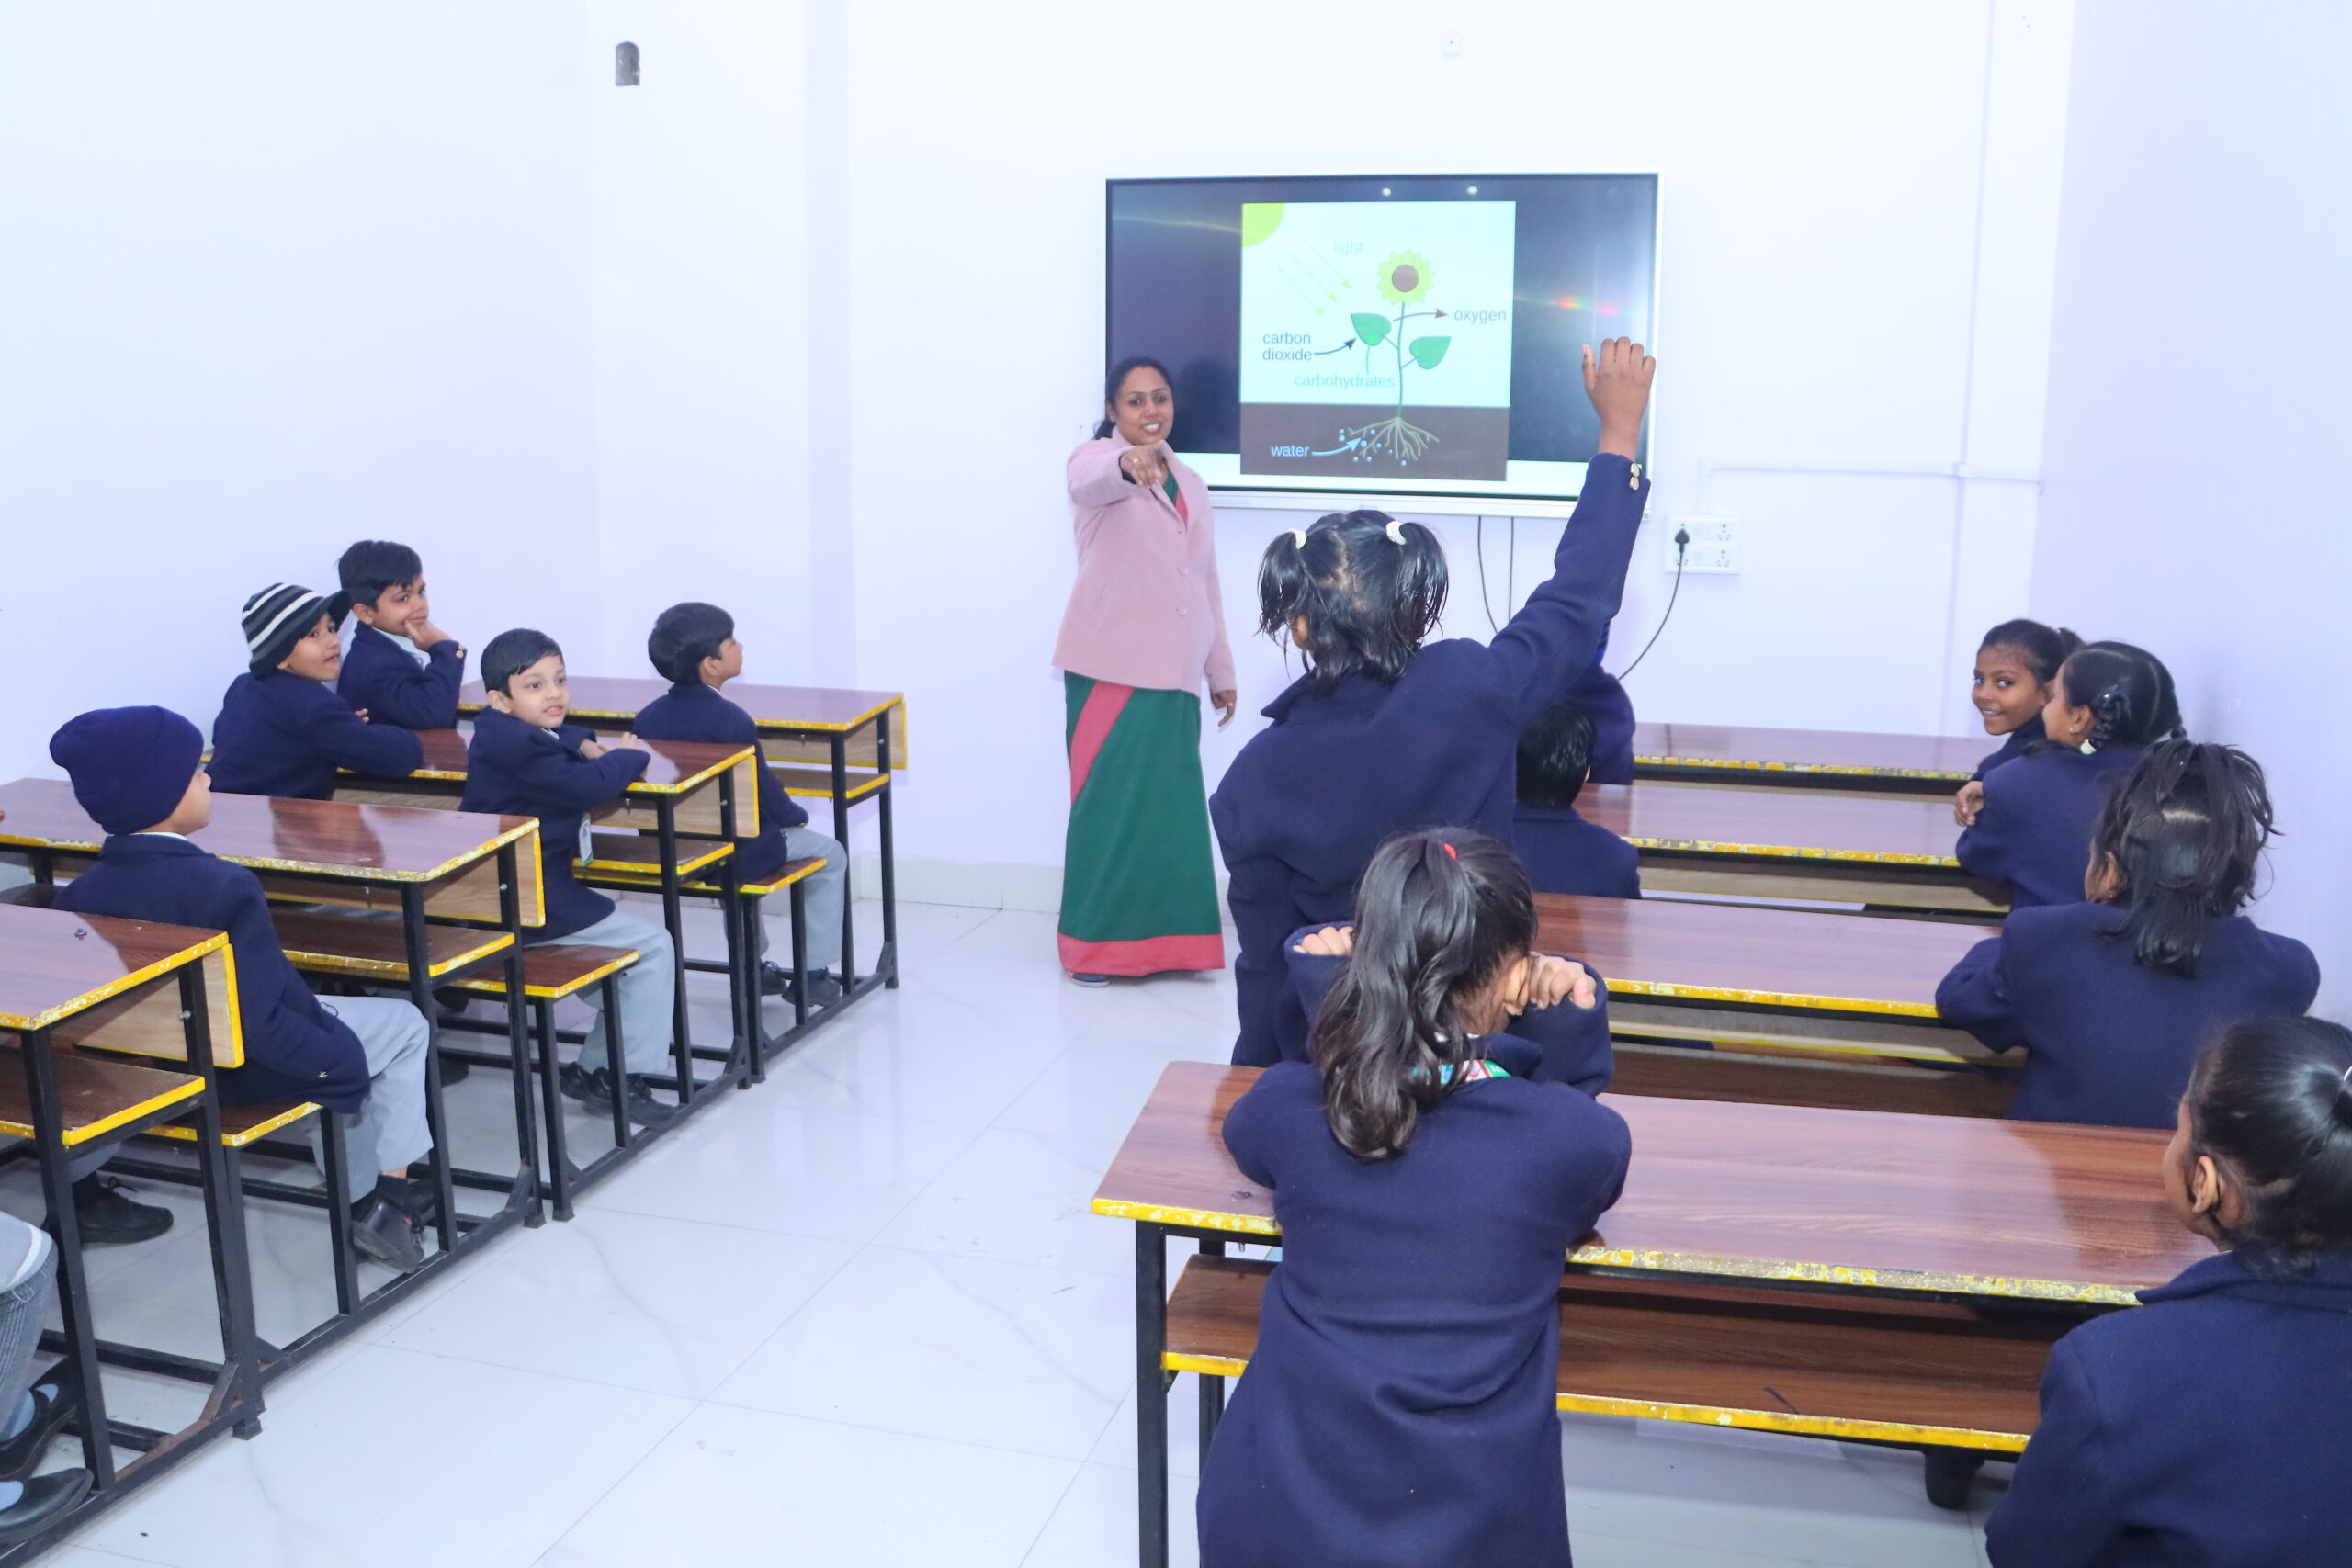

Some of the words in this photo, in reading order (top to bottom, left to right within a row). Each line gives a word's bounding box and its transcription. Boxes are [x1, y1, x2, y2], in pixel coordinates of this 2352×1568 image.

[1333, 240, 1363, 256] light
[1453, 308, 1507, 323] oxygen
[1262, 331, 1311, 344] carbon
[1262, 347, 1312, 361] dioxide
[1294, 374, 1396, 389] carbohydrates
[1270, 445, 1310, 457] water
